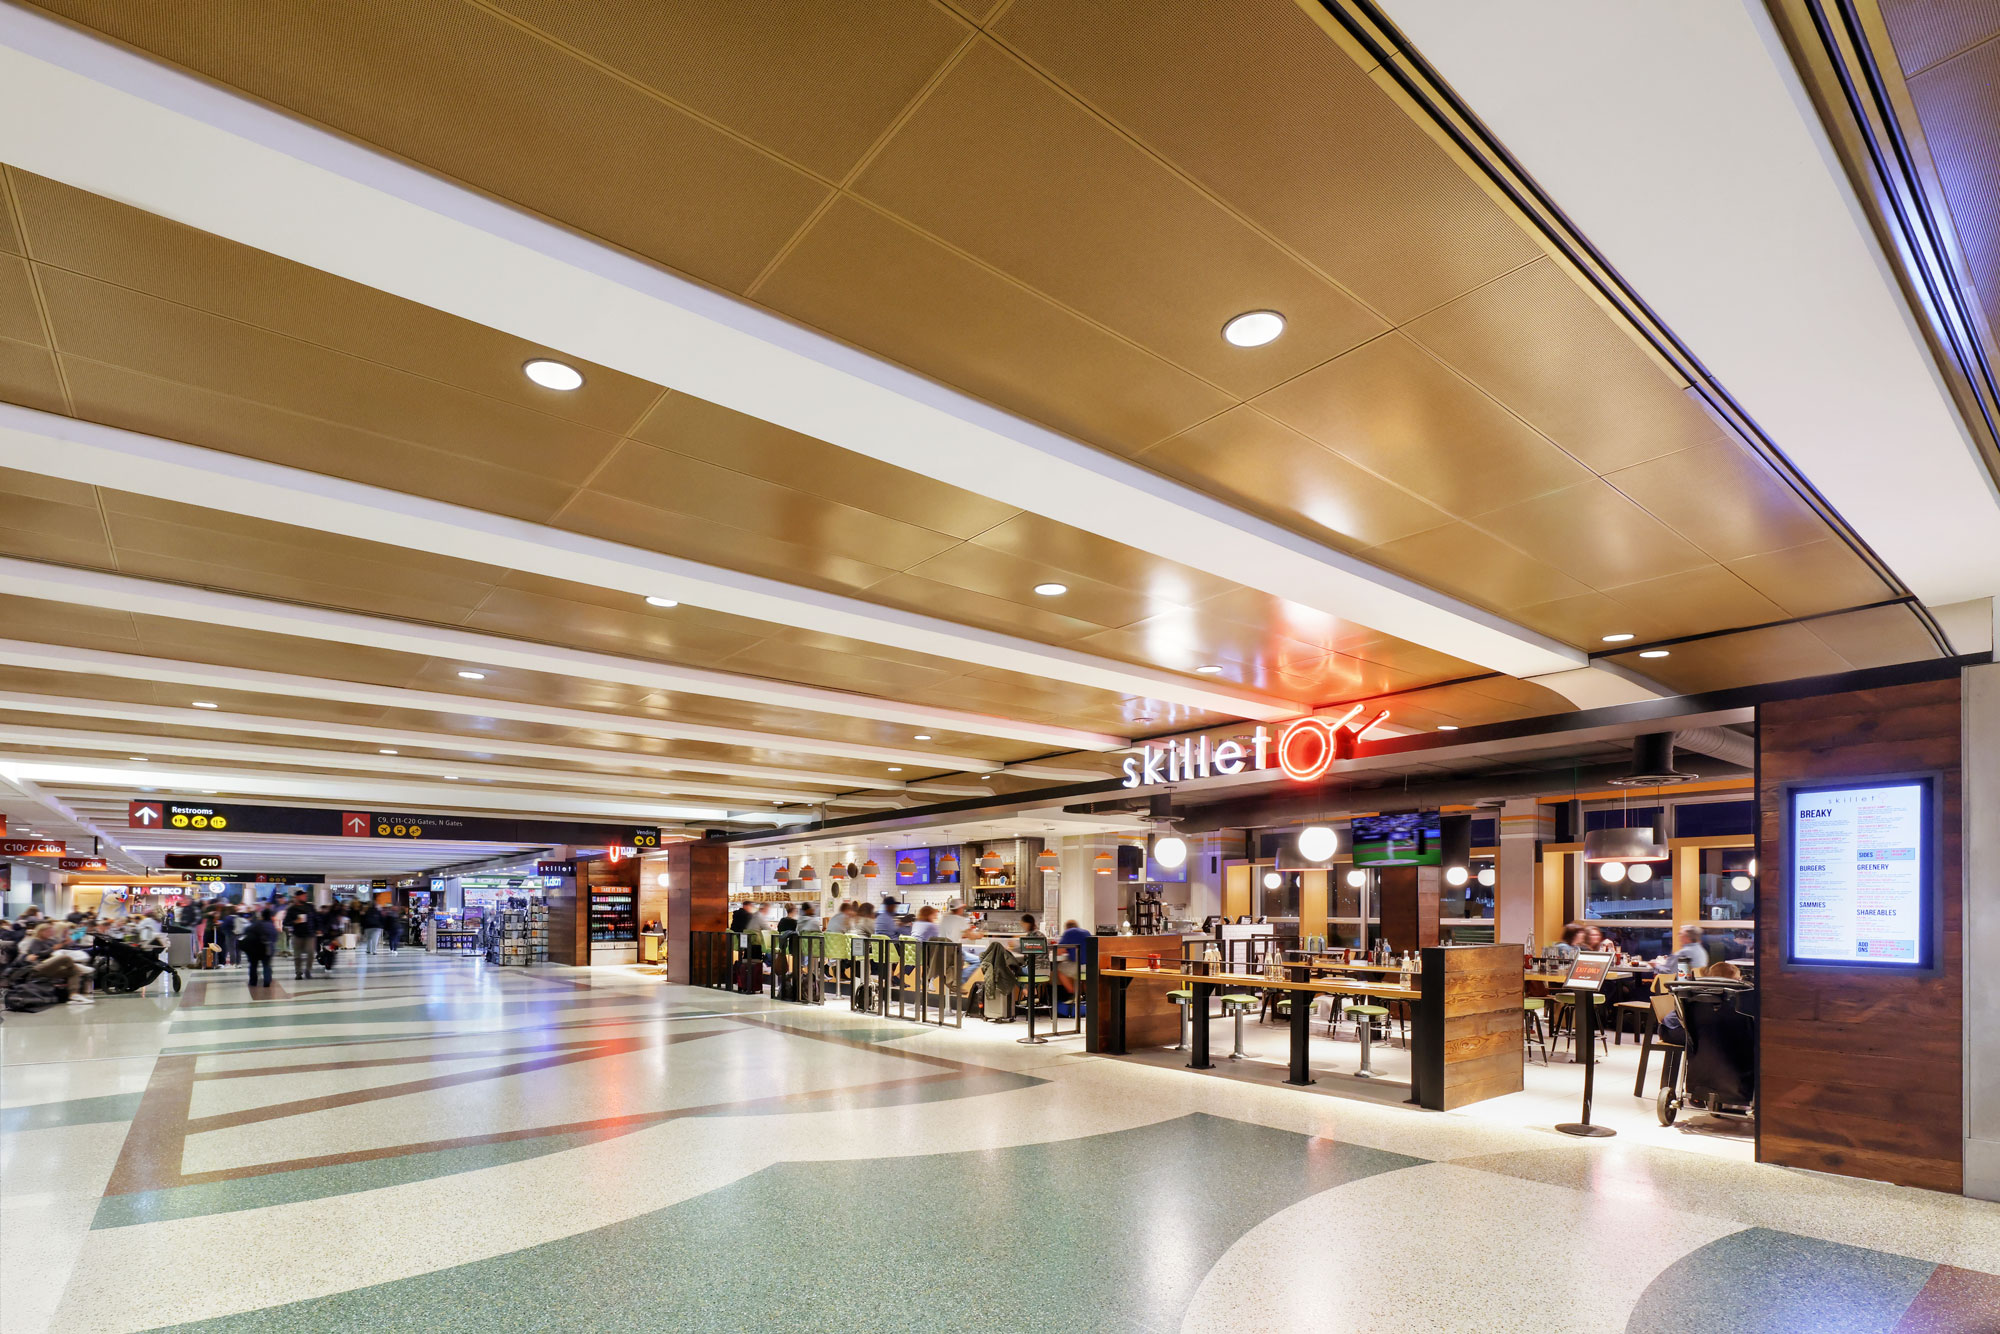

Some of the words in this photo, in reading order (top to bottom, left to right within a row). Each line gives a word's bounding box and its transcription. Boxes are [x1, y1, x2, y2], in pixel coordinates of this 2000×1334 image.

[1122, 726, 1272, 788] skillet
[1828, 795, 1875, 804] skillet
[171, 806, 213, 815] Restrooms
[1800, 809, 1832, 819] BREAKY
[377, 816, 389, 824] C9,
[417, 818, 437, 826] Gates,
[199, 858, 219, 867] C10
[132, 886, 182, 895] HACHIKO
